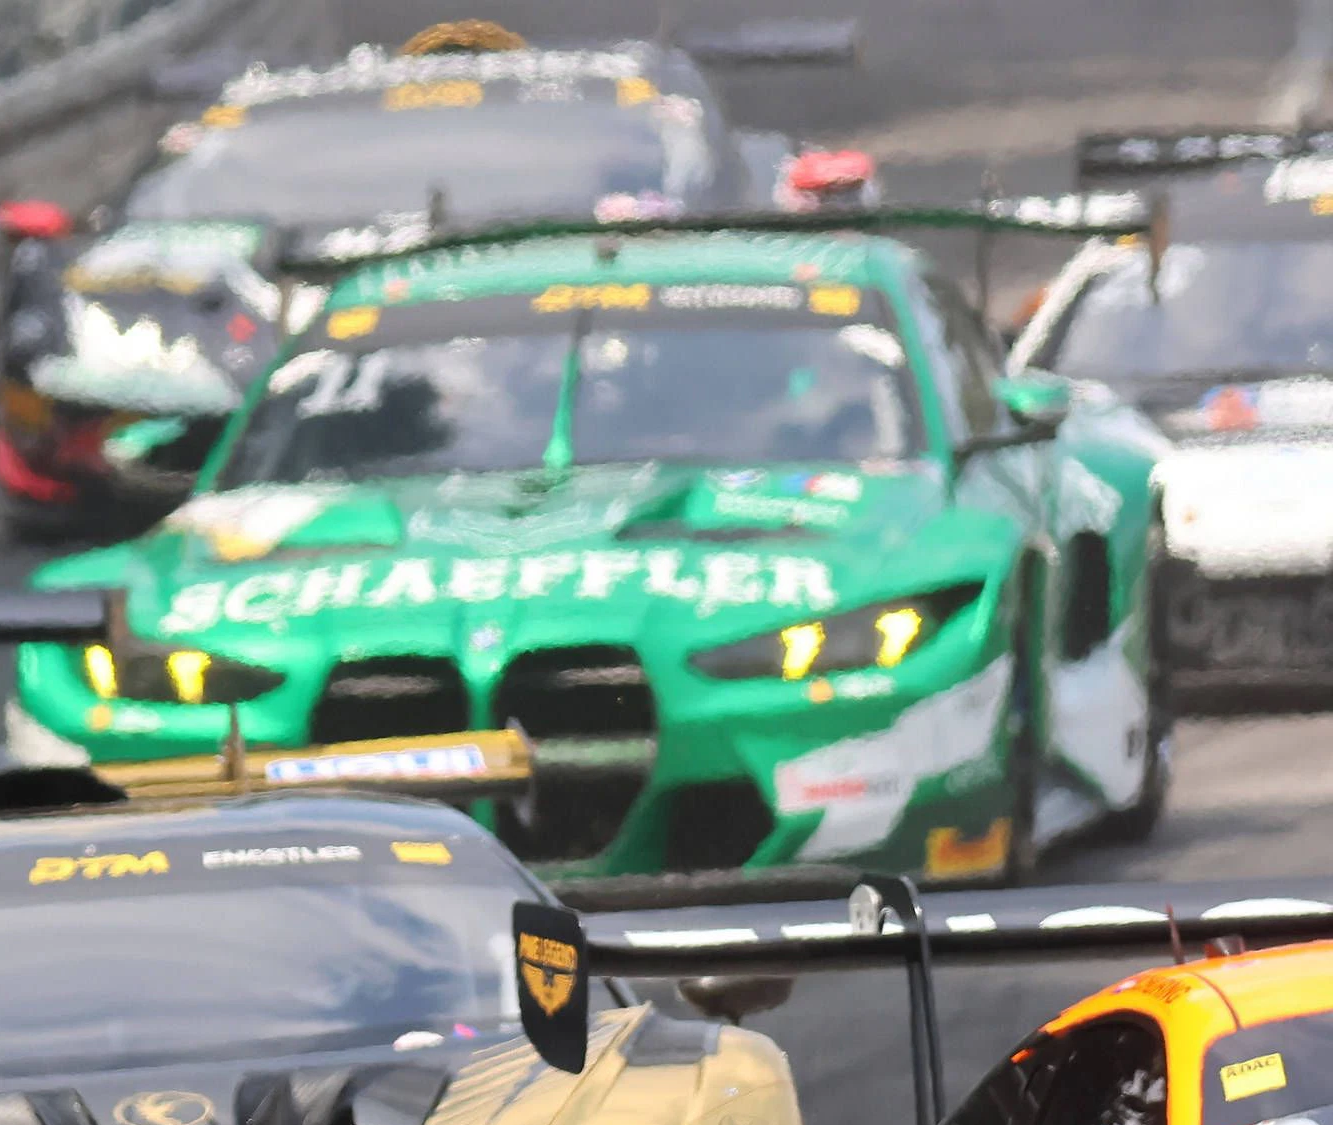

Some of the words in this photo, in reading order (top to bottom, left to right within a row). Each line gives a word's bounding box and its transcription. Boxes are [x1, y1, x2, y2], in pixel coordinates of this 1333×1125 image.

[160, 547, 837, 635] SCHAEFFLER
[29, 850, 170, 884] DTM
[1225, 1055, 1278, 1078] ADAC
